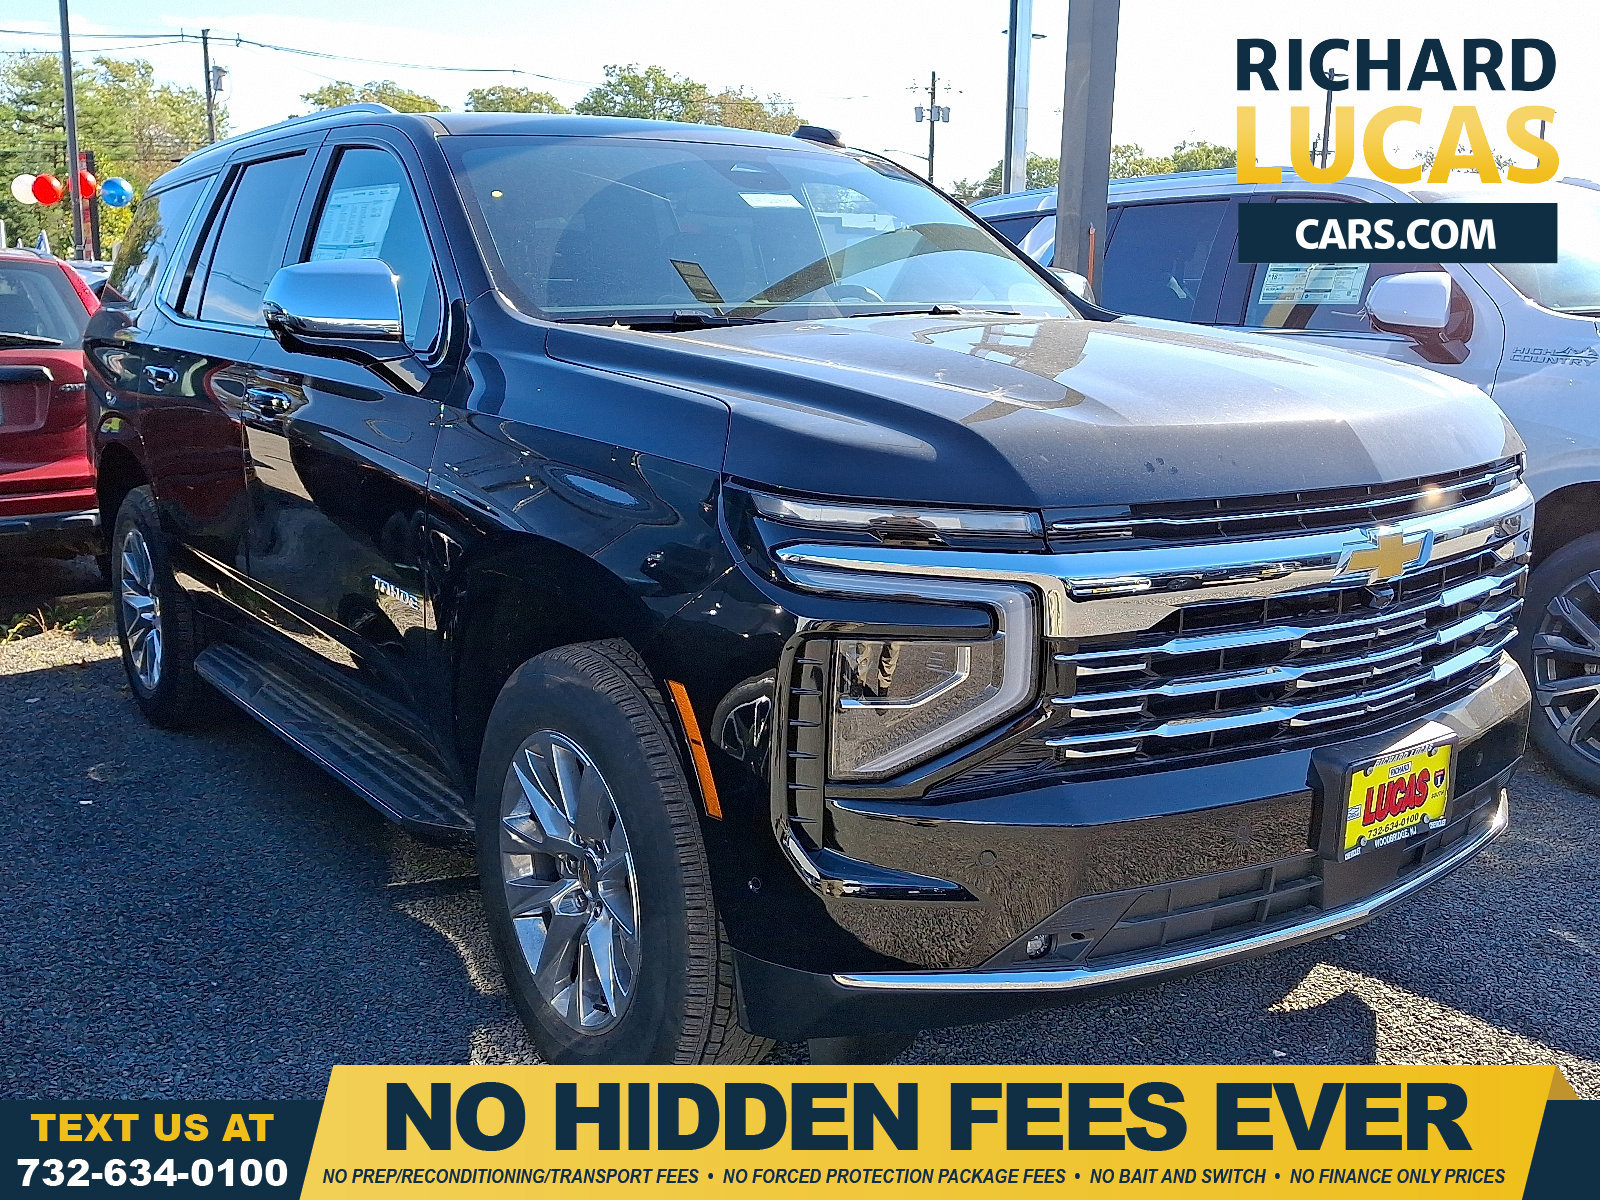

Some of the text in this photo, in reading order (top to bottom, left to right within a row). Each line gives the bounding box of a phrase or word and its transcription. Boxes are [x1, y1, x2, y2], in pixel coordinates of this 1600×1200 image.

[1510, 354, 1598, 367] COUNTRY
[1513, 346, 1557, 356] HIGH
[371, 574, 420, 611] TAHOE
[1362, 768, 1430, 827] LUCAS
[1367, 812, 1419, 839] 732-634-0100
